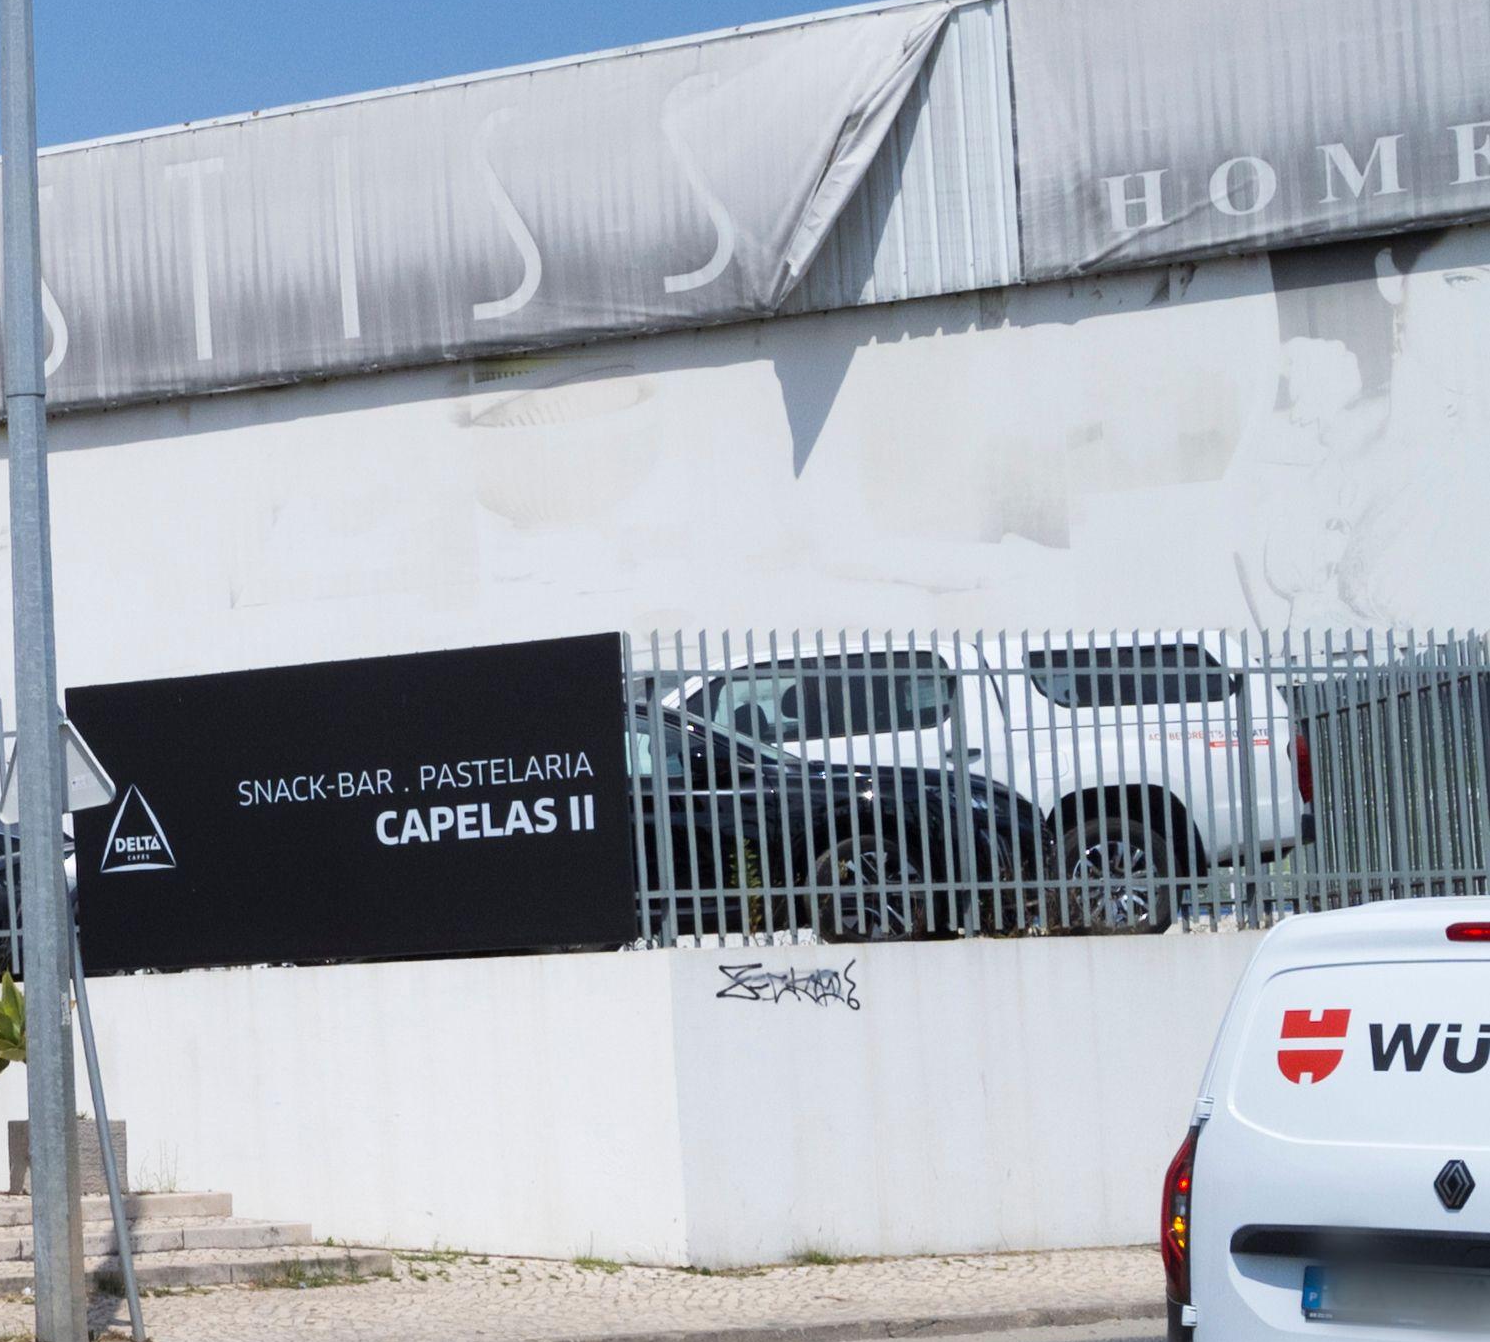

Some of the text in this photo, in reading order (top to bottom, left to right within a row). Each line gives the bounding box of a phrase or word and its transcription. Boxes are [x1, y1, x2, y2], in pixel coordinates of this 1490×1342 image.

[238, 769, 394, 806] SNACK-BAR
[420, 751, 594, 790] PASTELARIA
[115, 834, 162, 853] DELTA
[376, 794, 594, 845] CAPELAS II
